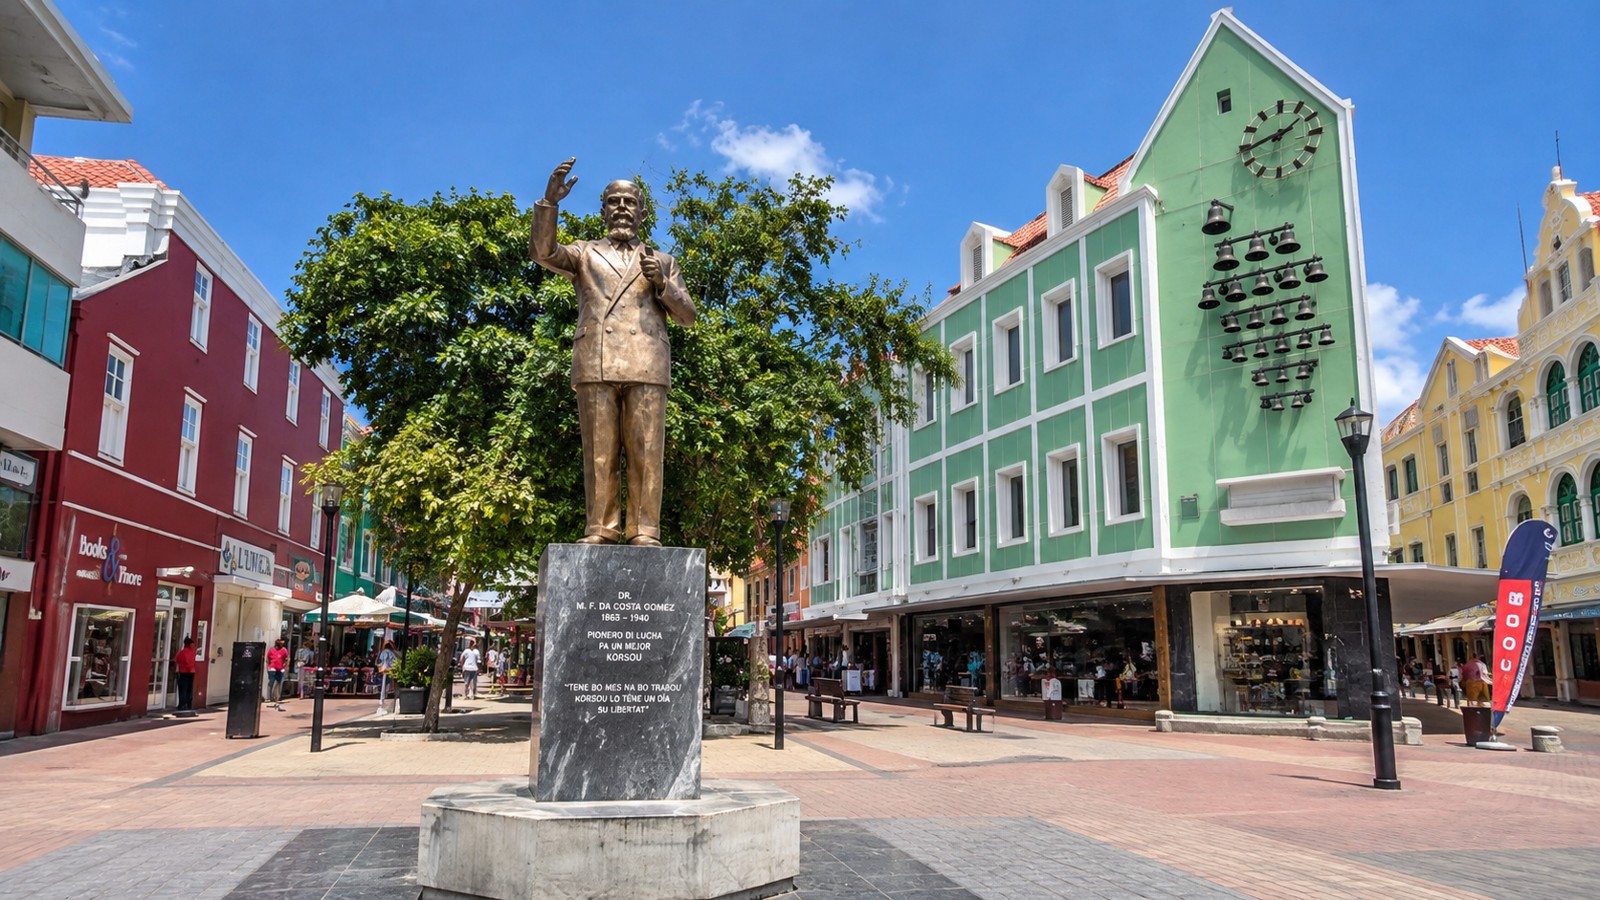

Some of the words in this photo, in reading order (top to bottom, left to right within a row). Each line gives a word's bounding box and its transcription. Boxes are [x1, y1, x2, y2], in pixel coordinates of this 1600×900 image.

[576, 601, 587, 610] M.
[589, 602, 596, 610] F.
[599, 602, 611, 610] DA
[613, 602, 641, 611] COSTA
[630, 614, 650, 622] 1940
[599, 642, 608, 650] PA
[606, 653, 642, 661] KORSOU
[575, 694, 607, 702] KORSOU
